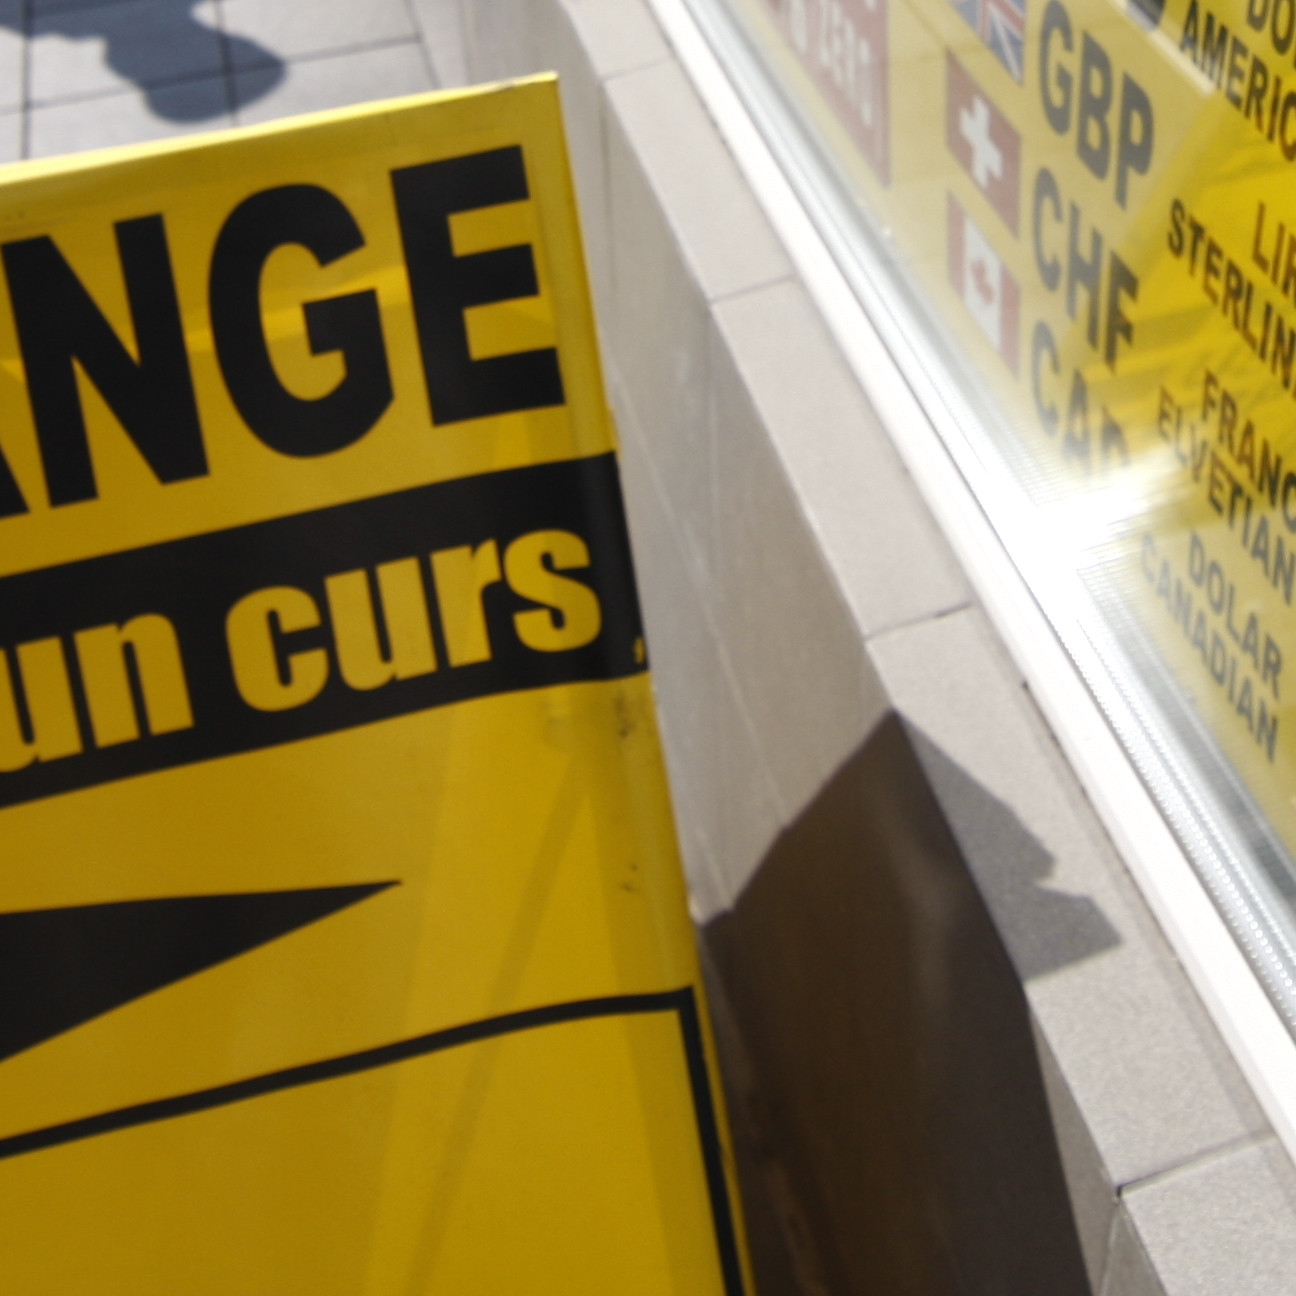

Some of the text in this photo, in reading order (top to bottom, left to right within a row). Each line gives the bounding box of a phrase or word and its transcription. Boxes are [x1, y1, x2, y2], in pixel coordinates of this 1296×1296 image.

[1032, 166, 1139, 376] CHF
[1157, 384, 1296, 608] ELVETIAN
[225, 528, 601, 713] curs
[1141, 531, 1278, 766] CANADIAN
[1190, 530, 1282, 700] DOLAR
